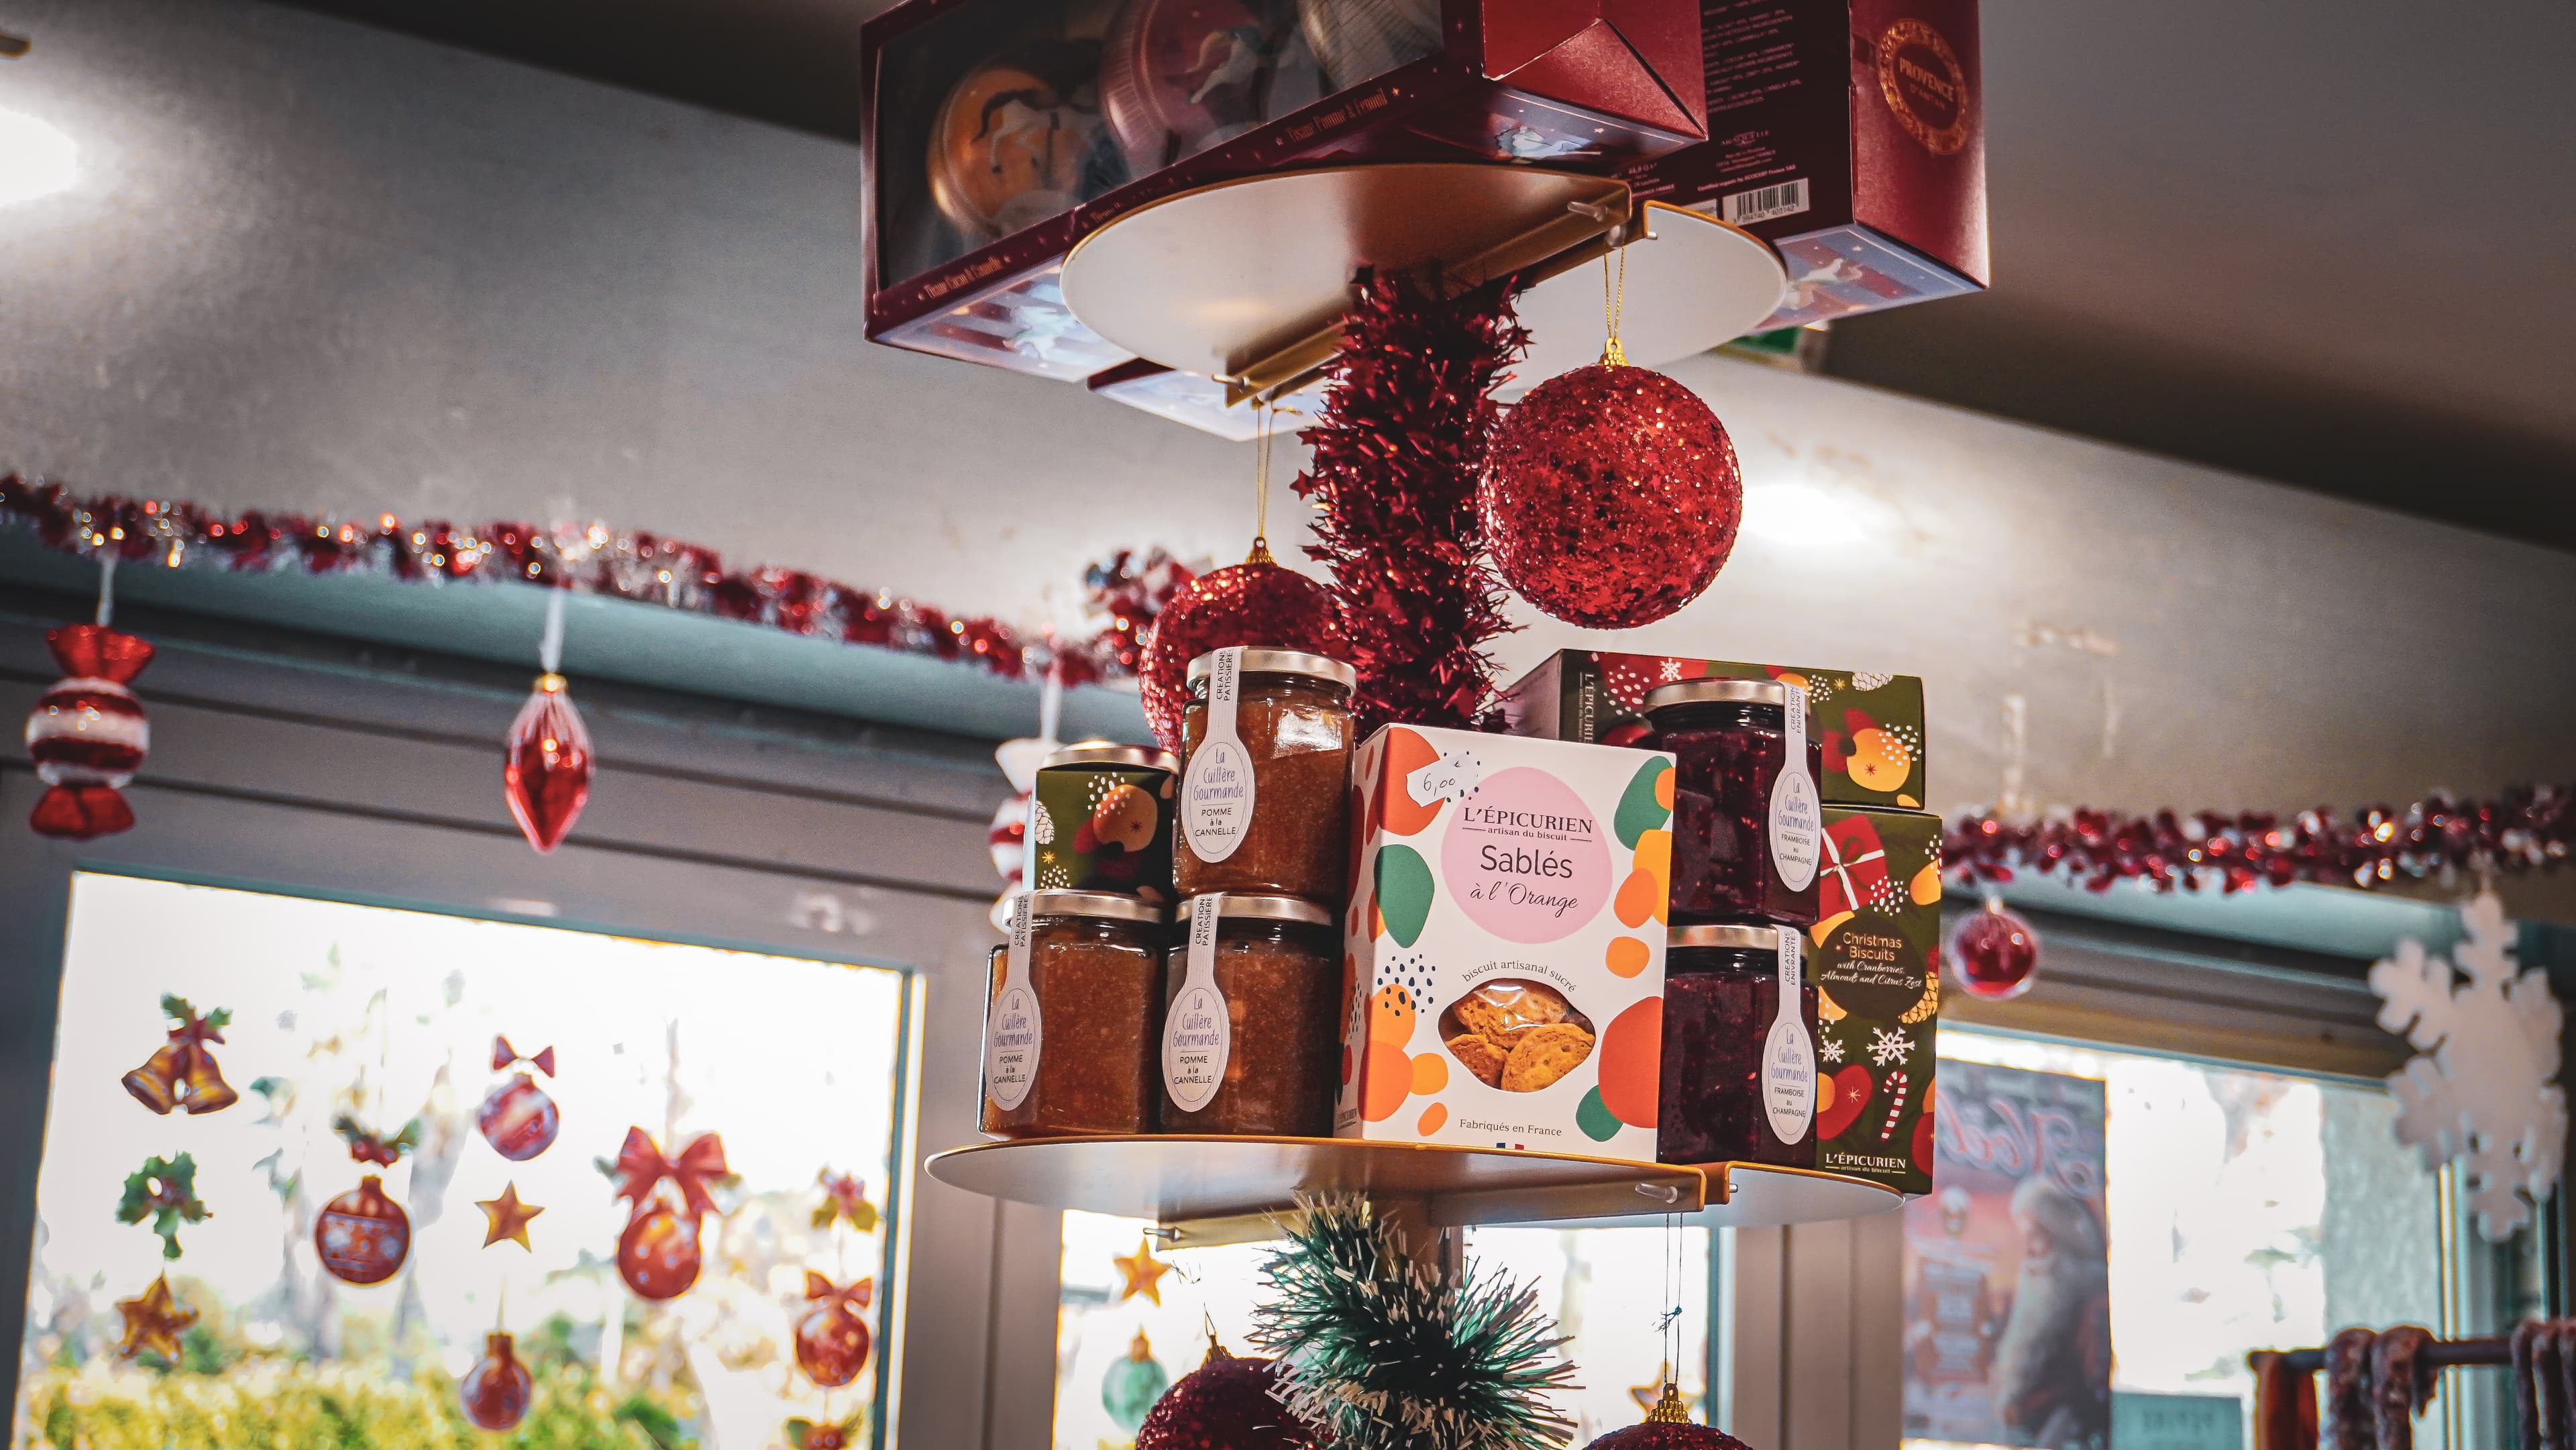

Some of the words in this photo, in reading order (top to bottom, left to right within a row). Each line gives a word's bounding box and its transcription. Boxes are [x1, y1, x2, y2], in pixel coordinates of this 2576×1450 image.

[1900, 57, 1953, 102] PROVENCE
[1216, 748, 1225, 764] La
[1203, 766, 1235, 784] Cuillère
[1193, 782, 1244, 800] Gourmande
[1424, 773, 1456, 796] 6,00
[1793, 778, 1800, 793] La
[1201, 807, 1232, 817] POMME
[1784, 794, 1808, 815] Cuillère
[1216, 818, 1222, 826] la
[1463, 806, 1593, 833] L'ÉPICURIEN
[1778, 810, 1814, 831] Gourmande
[1195, 827, 1236, 837] CANNELLE
[1488, 827, 1519, 836] artisan
[1537, 831, 1567, 841] biscuit
[1781, 834, 1810, 845] FRAMBOISE
[1481, 845, 1572, 878] Sablés
[1779, 853, 1812, 865] CHAMPAGNE
[1470, 883, 1485, 899] à
[1843, 932, 1902, 949] Christmas
[1849, 945, 1895, 962] Biscuits
[1837, 960, 1855, 969] with
[1462, 960, 1497, 982] biscuit
[1501, 960, 1548, 974] artisanal
[1549, 970, 1577, 992] sucré
[1820, 970, 1858, 982] Almonds
[1860, 973, 1877, 984] and
[1878, 974, 1902, 986] Citrus
[1904, 976, 1922, 989] Zest
[1012, 994, 1019, 1010] La
[1194, 994, 1202, 1010] La
[1002, 1013, 1026, 1031] Cuillère
[1182, 1013, 1212, 1030] Cuillère
[994, 1029, 1032, 1047] Gourmande
[1173, 1029, 1219, 1047] Gourmande
[1786, 1028, 1794, 1044] La
[1000, 1055, 1023, 1064] POMME
[1180, 1055, 1208, 1064] POMME
[1778, 1047, 1802, 1065] Cuillère
[1006, 1066, 1009, 1074] à
[1187, 1066, 1191, 1074] à
[1193, 1066, 1199, 1074] la
[1771, 1063, 1808, 1082] Gourmande
[994, 1074, 1026, 1084] CANNELLE
[1174, 1075, 1212, 1084] CANNELLE
[1774, 1087, 1805, 1097] FRAMBOISE
[1772, 1107, 1806, 1118] CHAMPAGNE
[1460, 1119, 1509, 1132] Fabriqués
[1513, 1125, 1524, 1133] en
[1527, 1125, 1562, 1137] France
[1825, 1152, 1905, 1169] L'ÉPICURIEN
